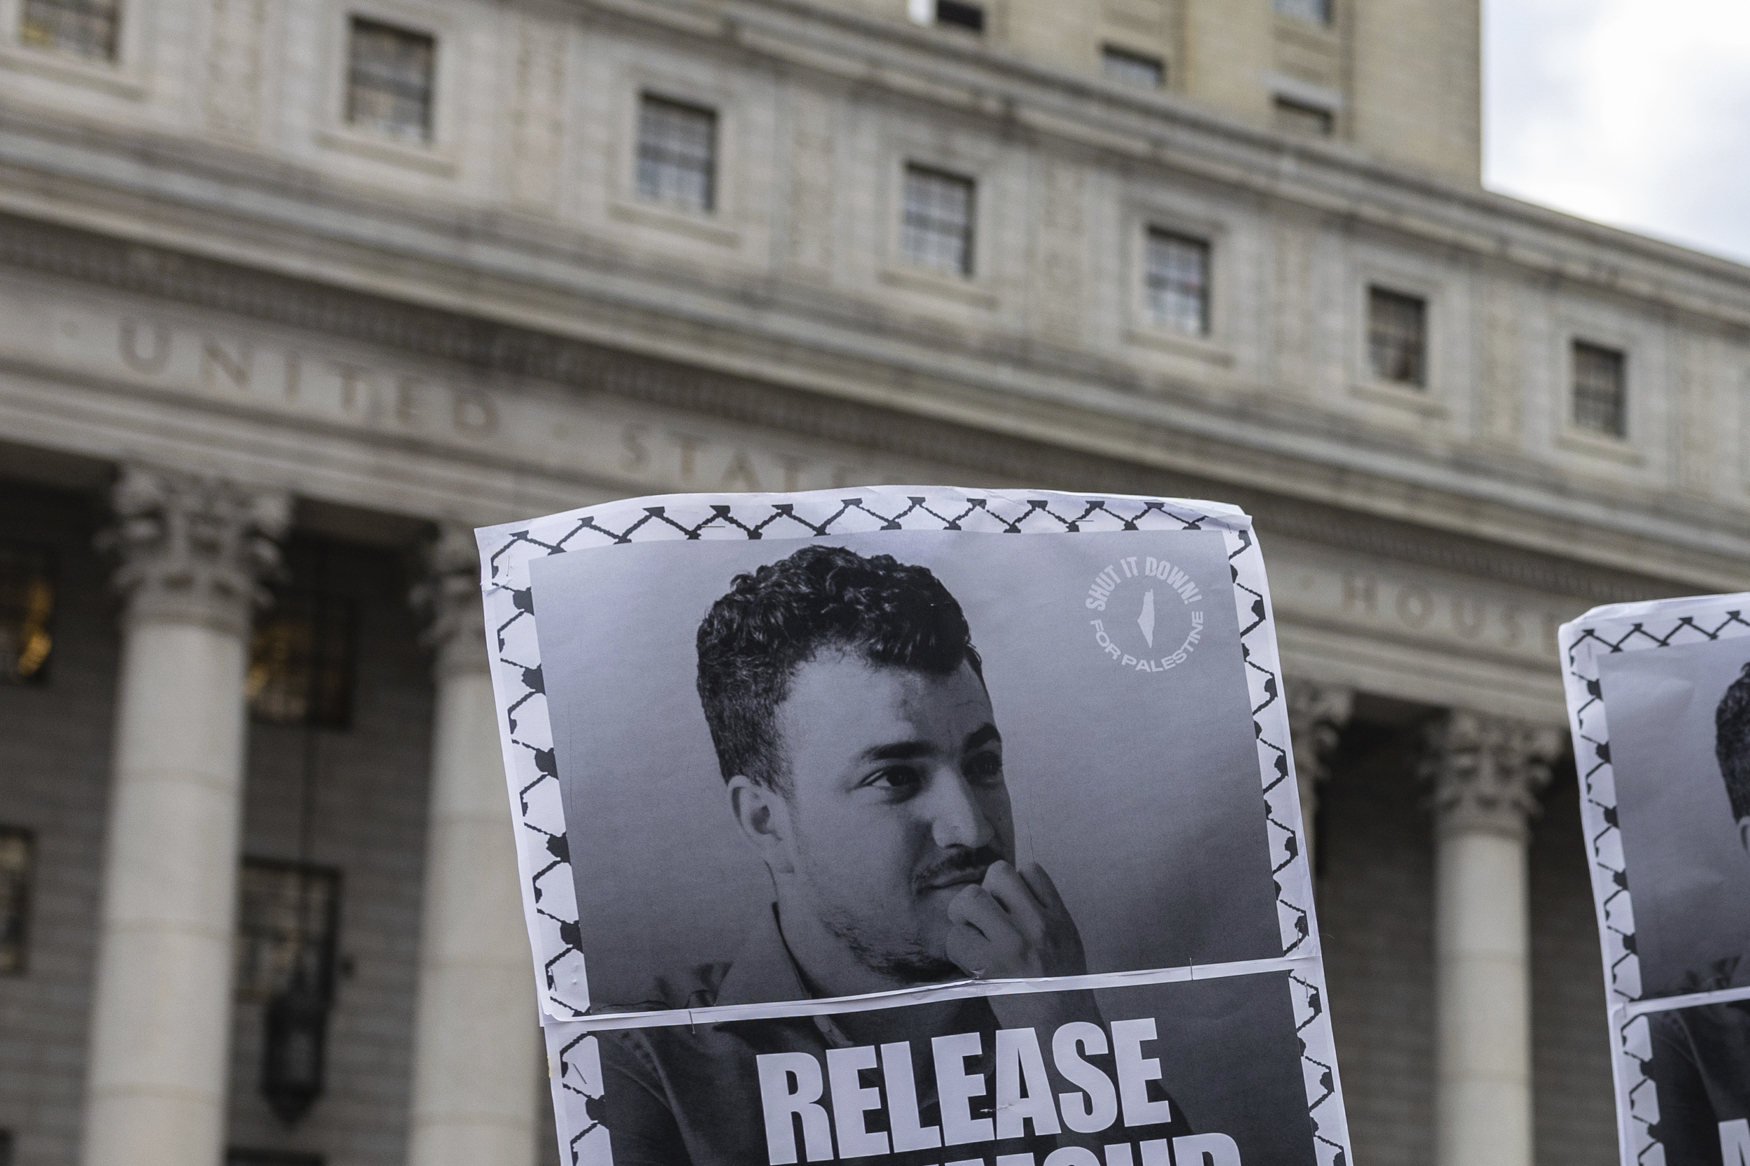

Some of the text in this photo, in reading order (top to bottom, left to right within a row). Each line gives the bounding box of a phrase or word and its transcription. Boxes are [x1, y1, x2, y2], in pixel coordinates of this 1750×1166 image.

[118, 315, 498, 437] UNITED
[1085, 556, 1203, 612] SHUT IT DOWN!
[1090, 610, 1204, 673] FOR PALESTINE
[756, 1017, 1171, 1166] RELEASE
